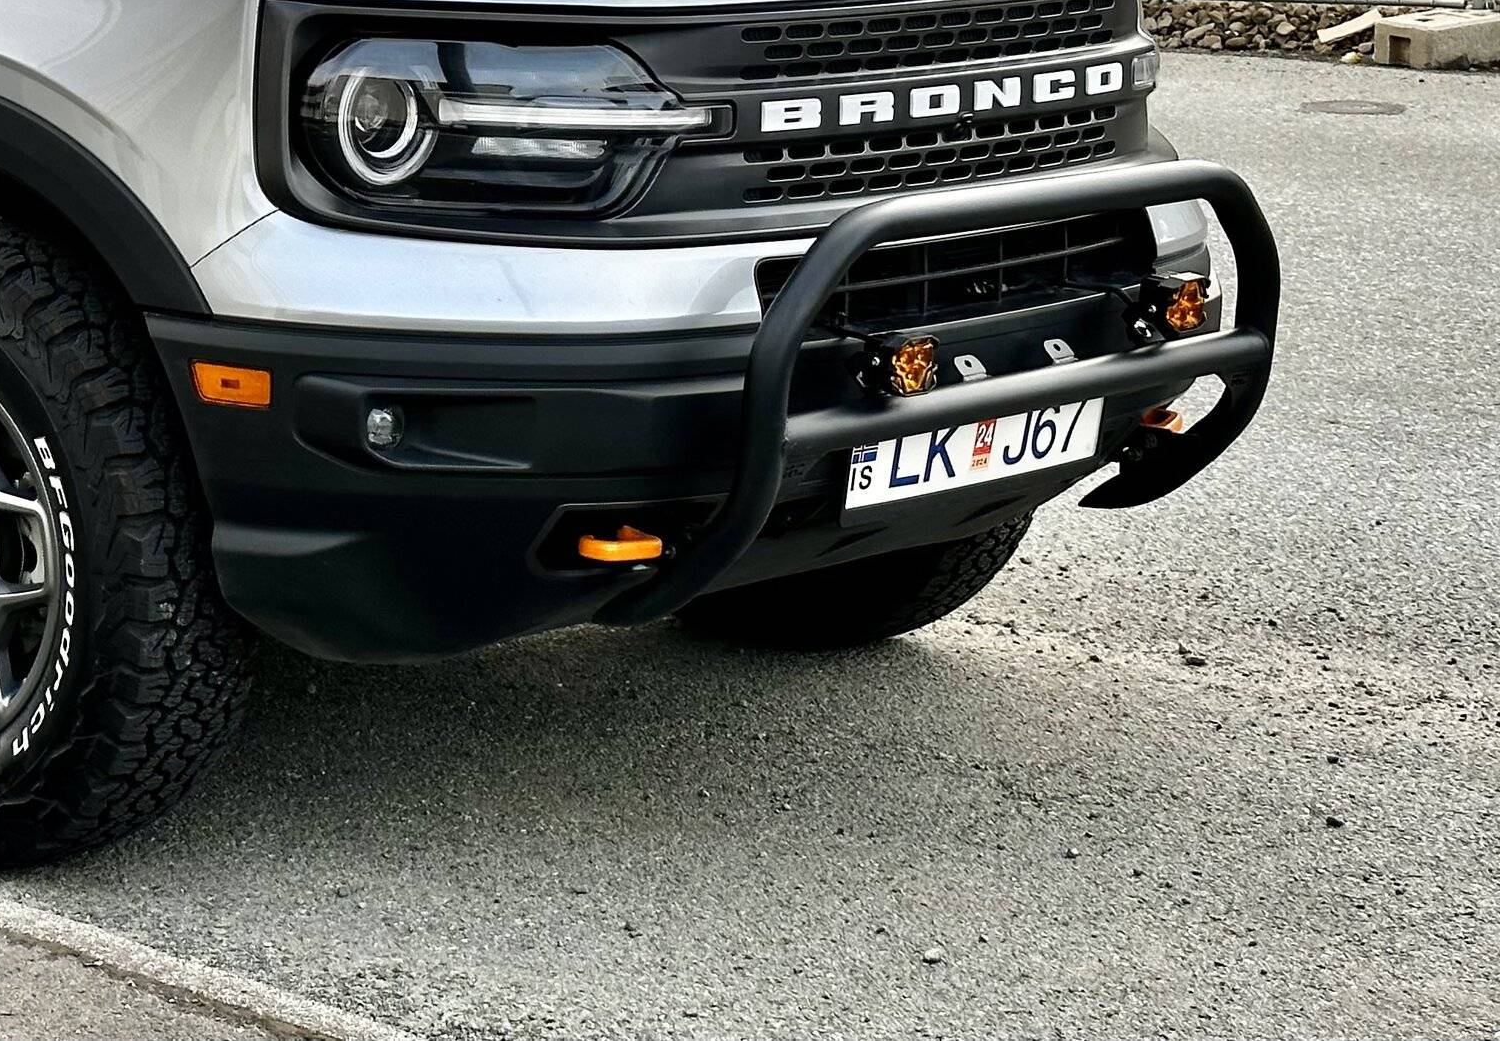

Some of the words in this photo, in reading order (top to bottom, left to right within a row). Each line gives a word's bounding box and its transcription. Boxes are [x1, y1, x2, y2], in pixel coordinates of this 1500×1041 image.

[761, 62, 1124, 133] BRONCO
[889, 426, 960, 488] LK
[1003, 400, 1088, 465] J67
[976, 422, 994, 448] 24
[850, 465, 873, 491] IS
[12, 436, 76, 756] BFGoodrich
